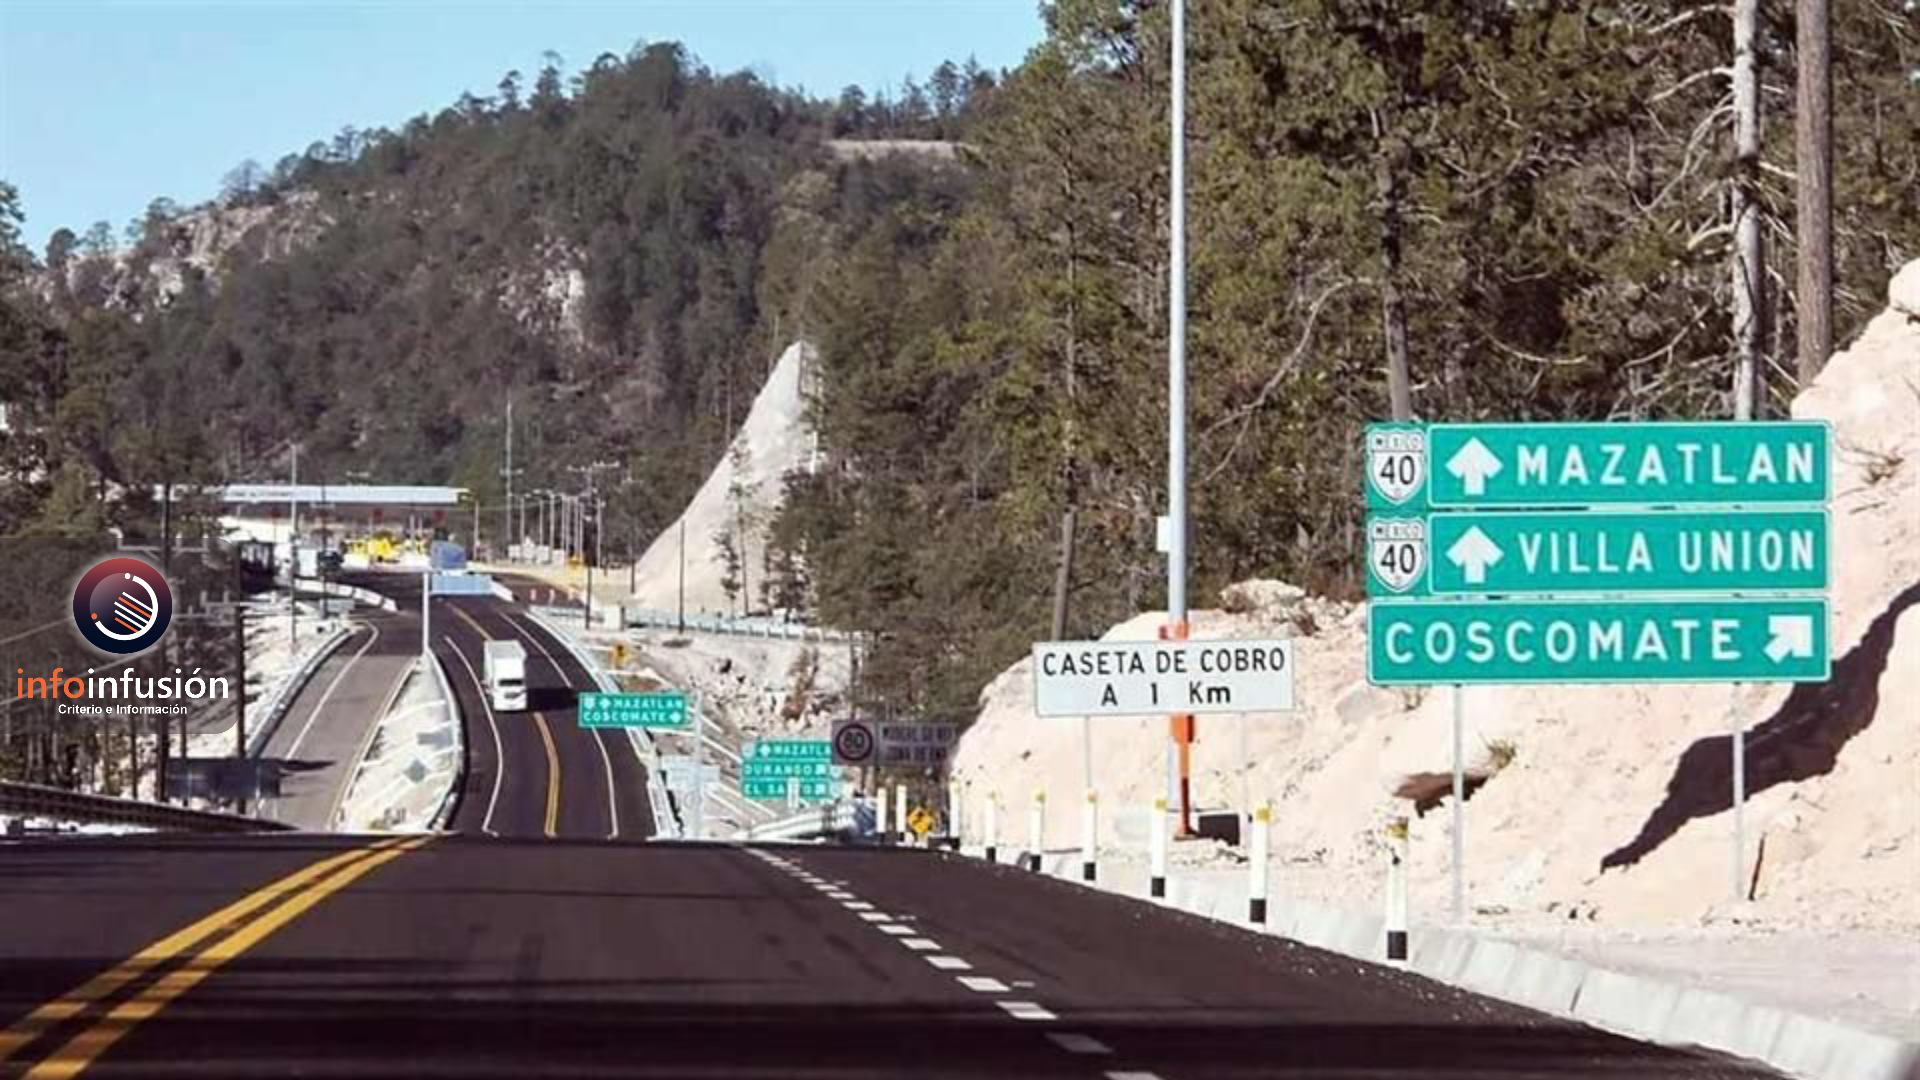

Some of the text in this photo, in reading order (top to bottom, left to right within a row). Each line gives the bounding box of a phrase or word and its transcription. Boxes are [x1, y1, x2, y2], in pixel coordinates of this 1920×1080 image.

[1380, 455, 1415, 485] 40
[1516, 443, 1815, 485] MAZATLAN
[1380, 544, 1416, 574] 40
[1518, 530, 1815, 573] VILLA UNION
[1384, 621, 1742, 663] COSCOMATE
[1043, 648, 1285, 676] CASETA DE COBRO
[613, 698, 683, 709] MAZATLAN
[1101, 681, 1231, 706] A 1 Km
[583, 711, 667, 722] COSCOMATE
[773, 744, 832, 755] MAZATLA
[744, 763, 813, 775] DURANGO
[768, 783, 813, 795] SAO
